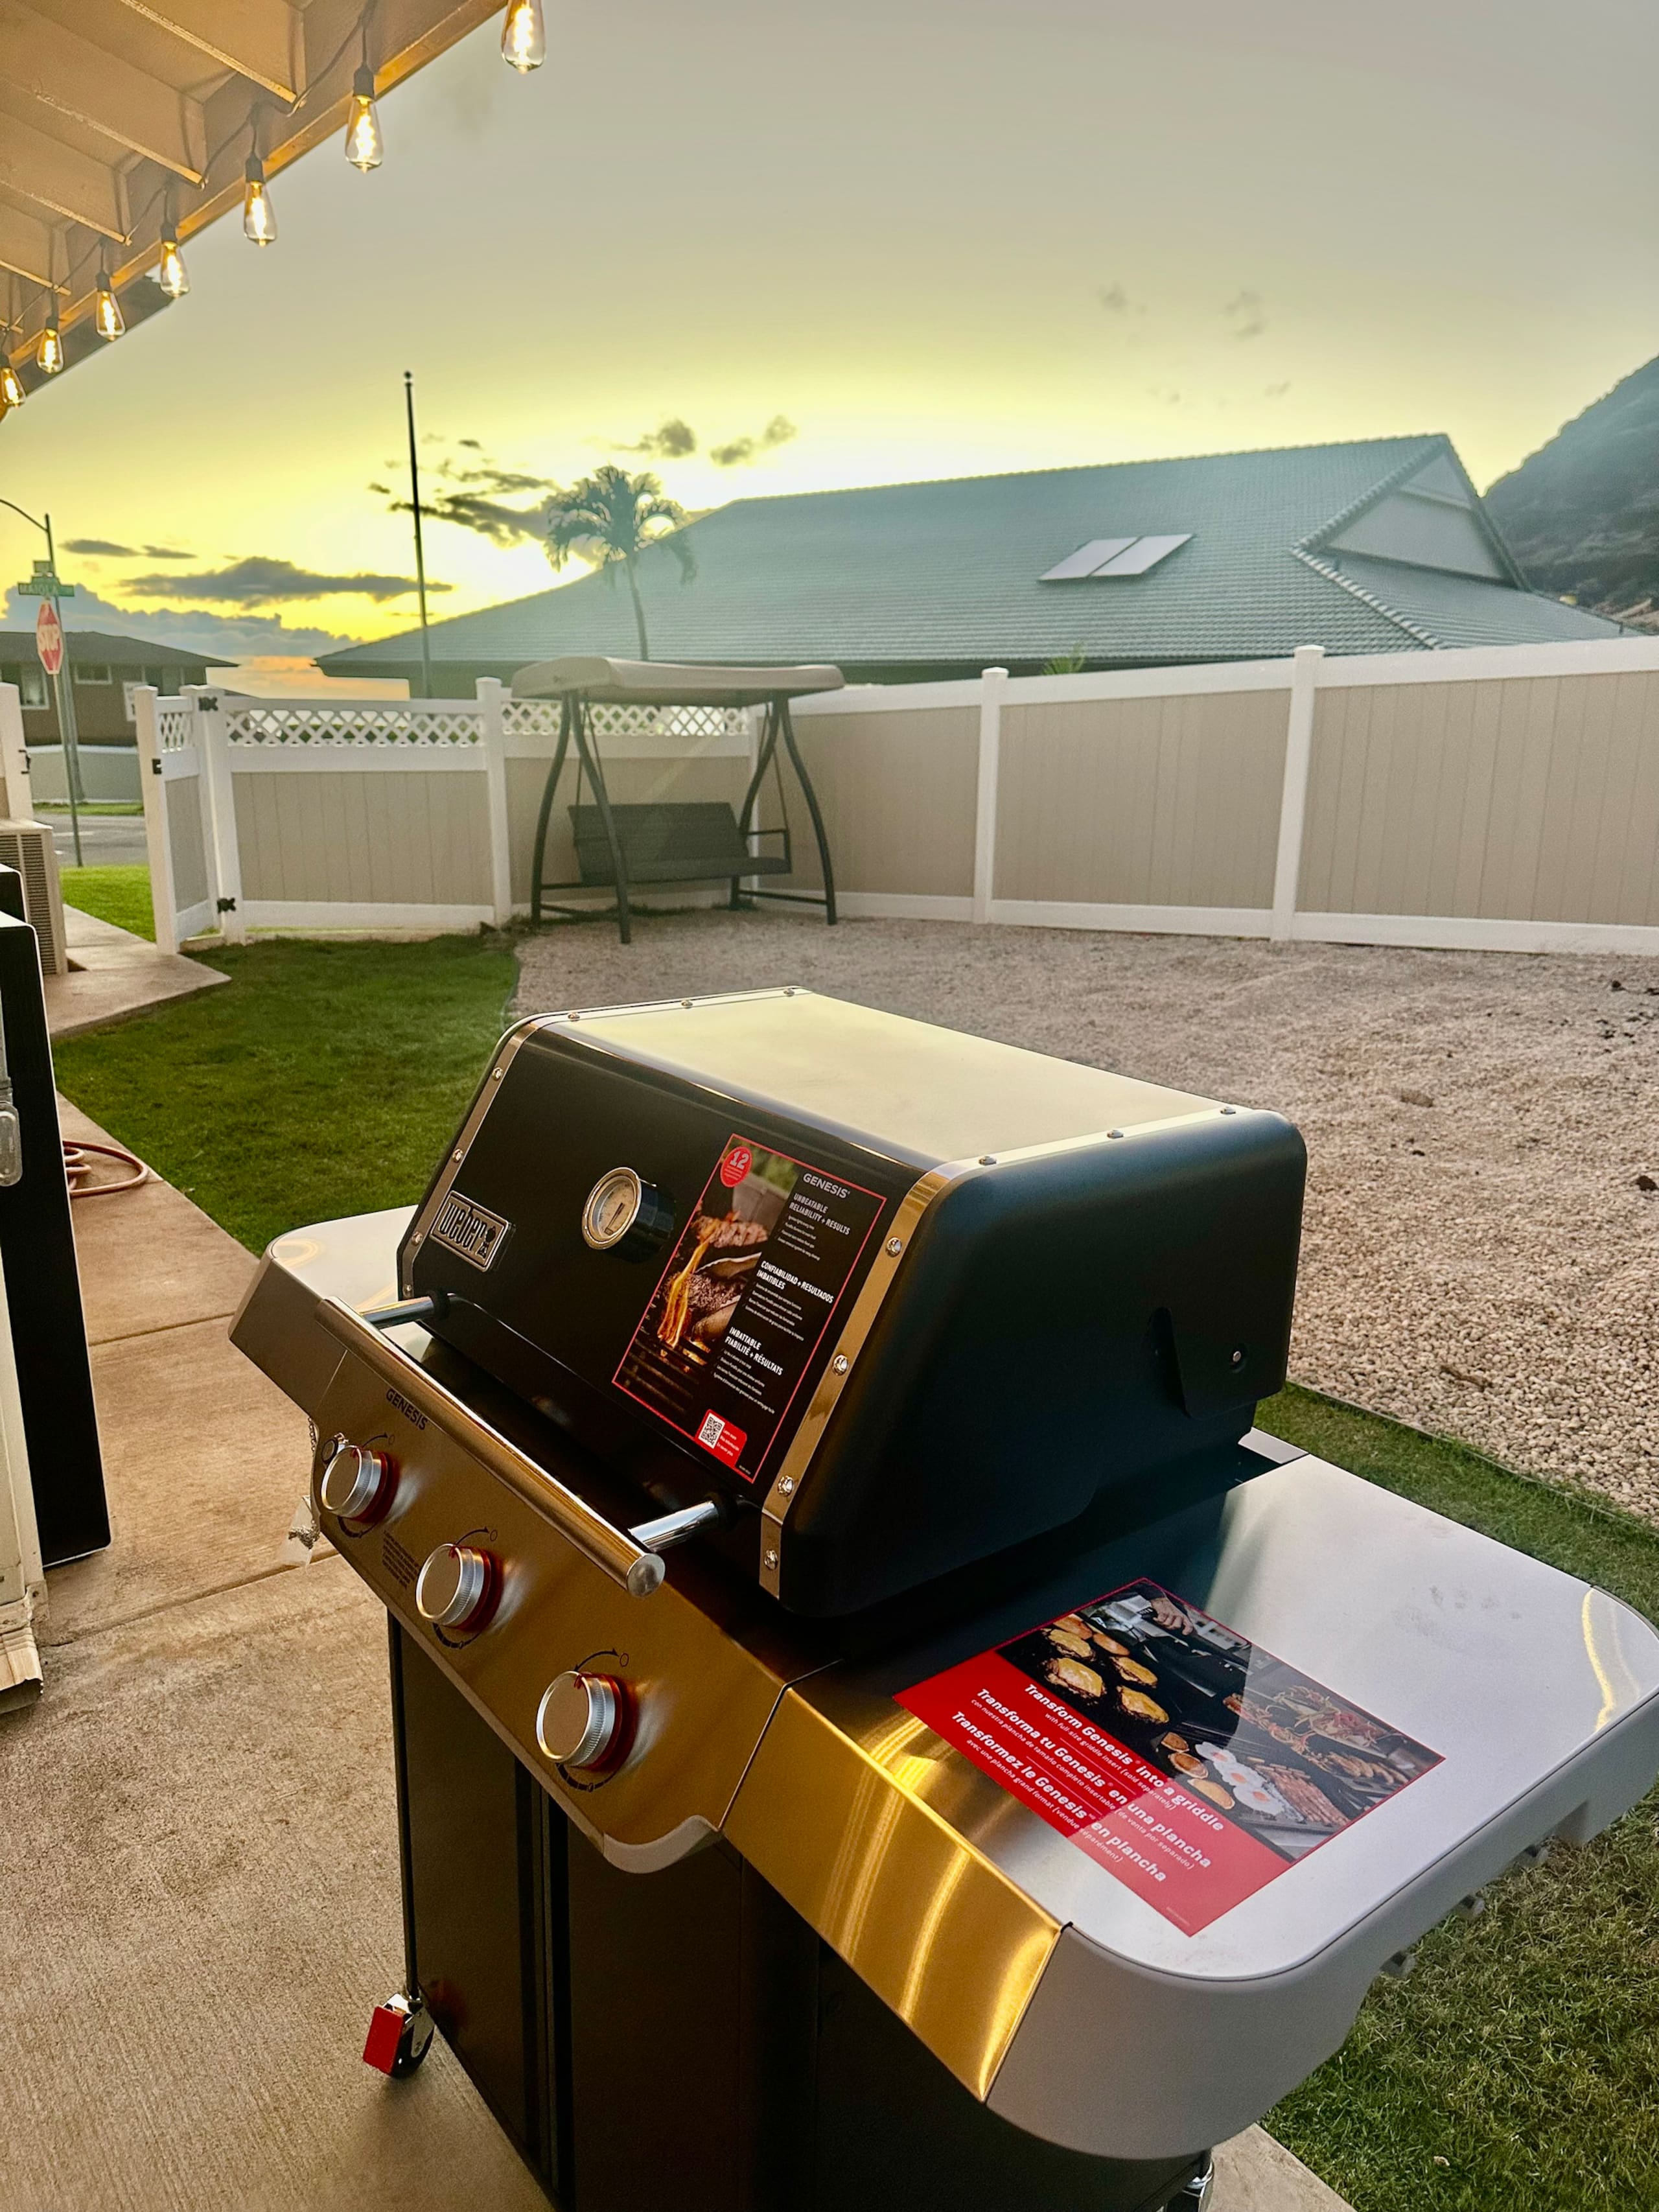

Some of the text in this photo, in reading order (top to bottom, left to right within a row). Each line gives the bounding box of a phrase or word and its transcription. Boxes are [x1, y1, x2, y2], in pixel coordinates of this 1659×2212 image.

[38, 623, 60, 651] STOP
[730, 1150, 749, 1168] 12
[789, 1202, 822, 1221] RELIABILITY
[825, 1218, 850, 1235] RESULTS
[793, 1193, 828, 1213] UNBEATABLE
[756, 1270, 785, 1289] IMBATIBLES
[761, 1261, 798, 1284] CONFIABILIDAD
[800, 1281, 833, 1303] RESULTADOS
[725, 1336, 750, 1355] FIABILITÉ
[753, 1353, 783, 1375] RÉSULTATS
[729, 1327, 761, 1349] IMBATTABLE
[386, 1388, 428, 1430] GENESIS
[1025, 1684, 1082, 1728] Transform
[1135, 1765, 1164, 1787] into
[1163, 1787, 1174, 1795] a
[1171, 1795, 1224, 1830] griddle
[1045, 1713, 1058, 1723] with
[1057, 1722, 1082, 1741] full-size
[1079, 1740, 1102, 1756] griddle
[1102, 1755, 1121, 1770] insert
[966, 1740, 981, 1751] avec
[980, 1749, 992, 1759] une
[990, 1758, 1015, 1778] plancha
[1013, 1777, 1034, 1792] grand
[1032, 1790, 1054, 1808] format
[971, 1699, 982, 1708] con
[981, 1707, 1003, 1724] nuestra
[1001, 1723, 1026, 1741] plancha
[1056, 1764, 1084, 1786] completo
[1084, 1784, 1115, 1810] insertable
[1128, 1818, 1146, 1833] venta
[1144, 1832, 1158, 1842] por
[977, 1688, 1040, 1738] Transforma
[1039, 1737, 1055, 1749] tu
[1109, 1789, 1127, 1804] en
[1127, 1803, 1154, 1824] una
[1150, 1823, 1211, 1867] plancha
[952, 1711, 1023, 1769] Transformez
[1021, 1766, 1036, 1778] le
[1091, 1822, 1109, 1837] en
[1106, 1836, 1165, 1881] plancha
